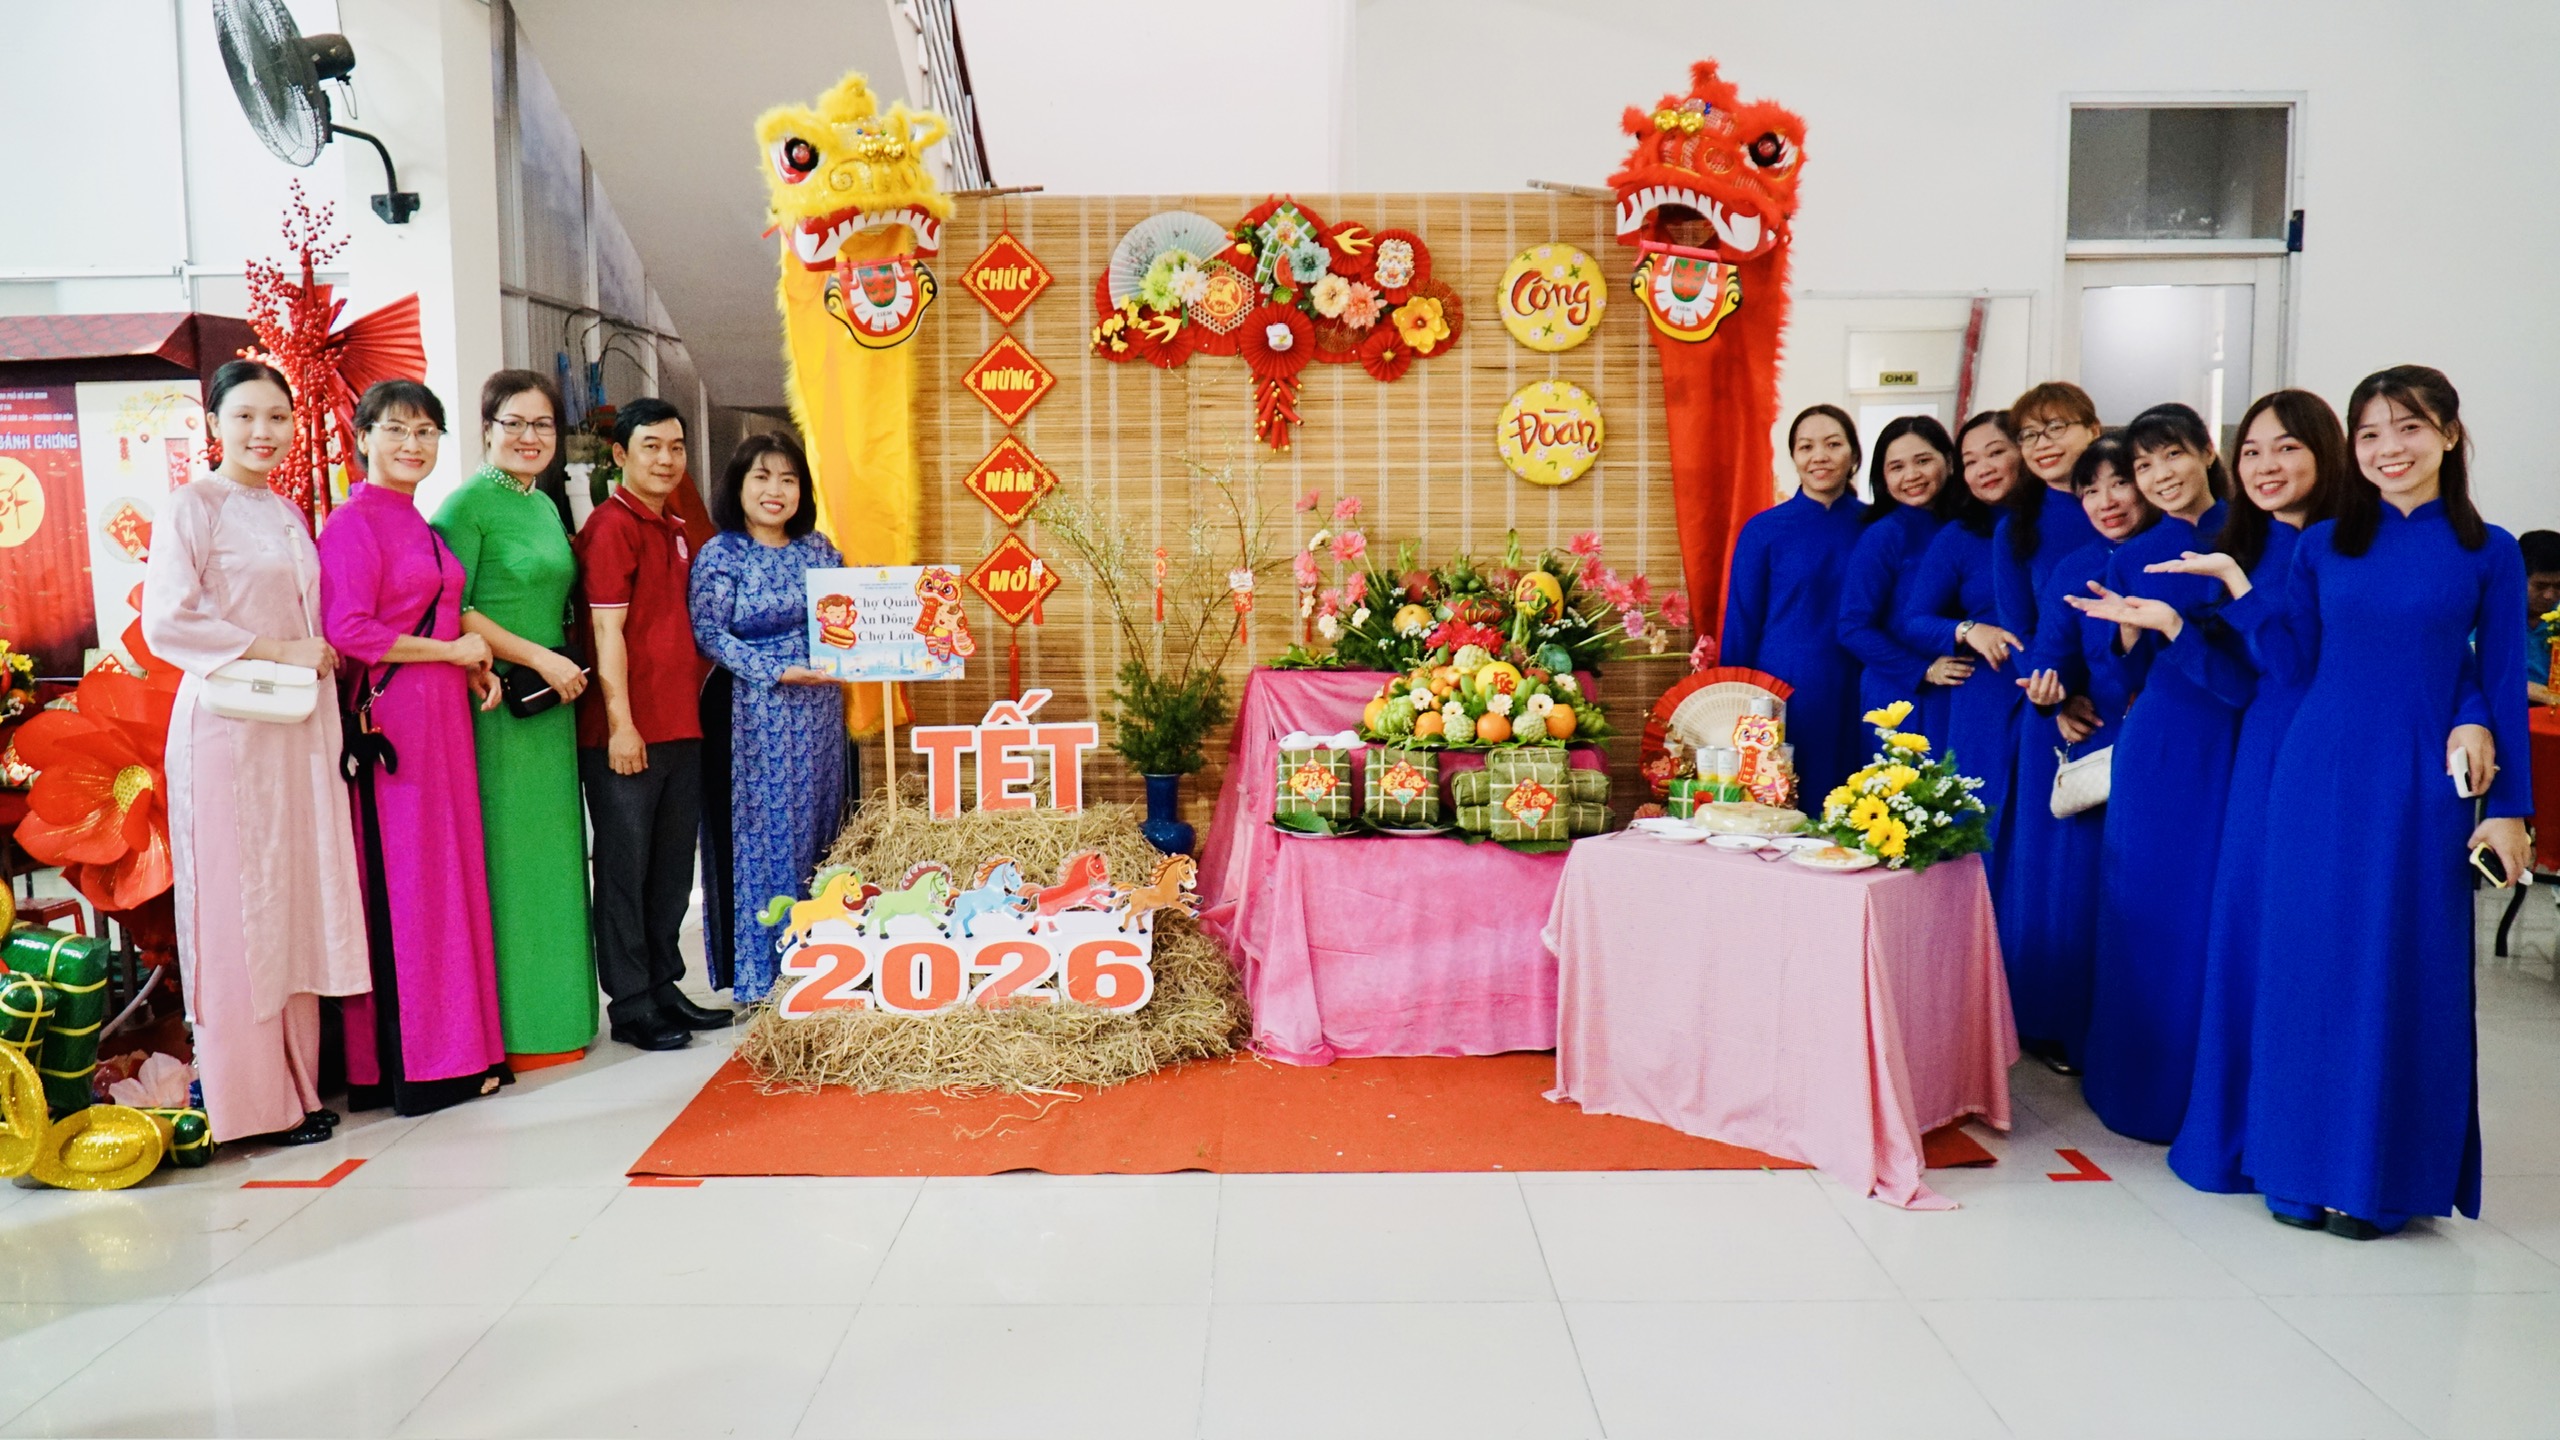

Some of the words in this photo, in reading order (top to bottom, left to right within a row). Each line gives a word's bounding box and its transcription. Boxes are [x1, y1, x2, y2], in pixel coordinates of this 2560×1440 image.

[976, 264, 1031, 291] CHÚC
[1511, 270, 1591, 326] Công
[981, 366, 1034, 391] MỪNG
[1509, 408, 1600, 454] Đoàn
[985, 467, 1035, 493] NĂM
[853, 596, 879, 611] Chợ
[883, 596, 917, 610] Quán
[859, 615, 876, 624] An
[858, 630, 885, 644] Chợ
[889, 630, 914, 641] Lớn
[913, 691, 1097, 819] TẾT
[784, 938, 1150, 1016] 2026
